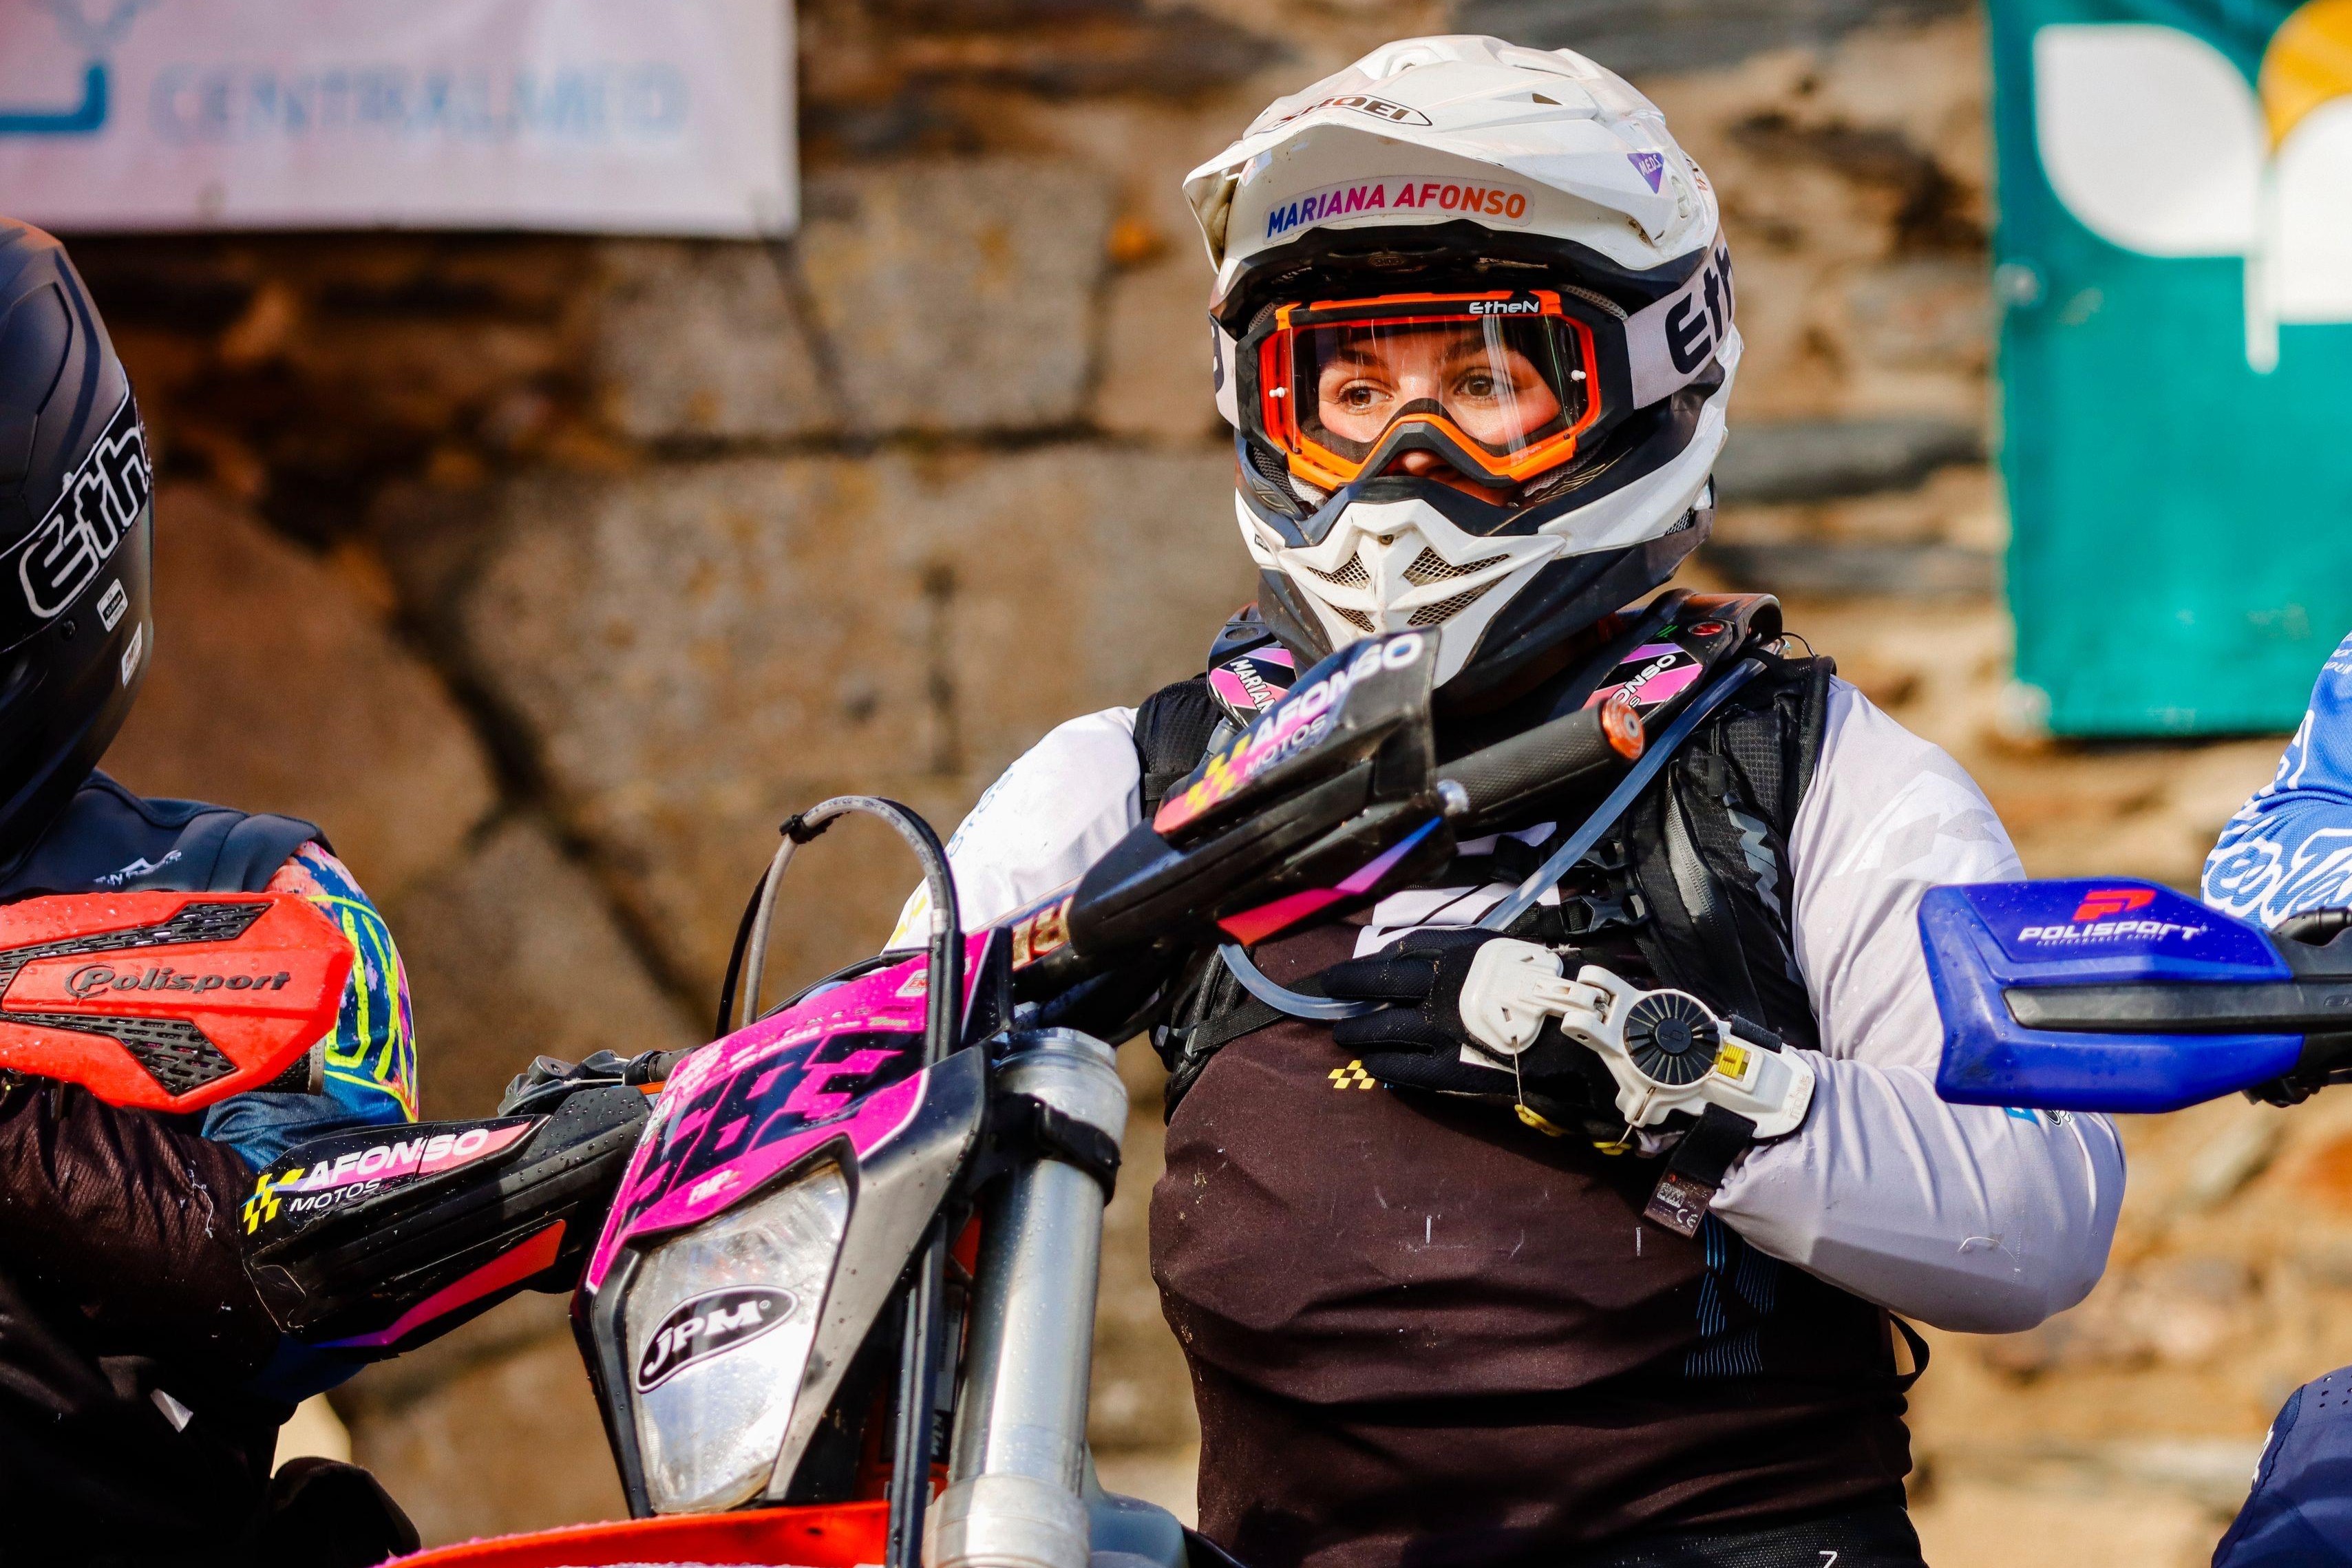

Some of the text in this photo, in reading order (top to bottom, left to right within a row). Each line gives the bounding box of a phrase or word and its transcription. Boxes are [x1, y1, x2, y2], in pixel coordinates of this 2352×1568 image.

[1267, 184, 1527, 239] MARIANA AFONSO
[1469, 300, 1539, 315] EtheN
[1229, 659, 1276, 714] MARIAN
[1249, 633, 1423, 756] AFONSO
[1611, 654, 1677, 703] ONSO
[1244, 714, 1327, 778] MOTOS
[2017, 921, 2201, 942] POLISPORT
[2036, 933, 2164, 946] PERFORMANCE PARTS
[65, 964, 291, 999] Polisport
[301, 1128, 489, 1191] AFONSO
[289, 1178, 381, 1213] MOTOS
[644, 1300, 763, 1377] JPM
